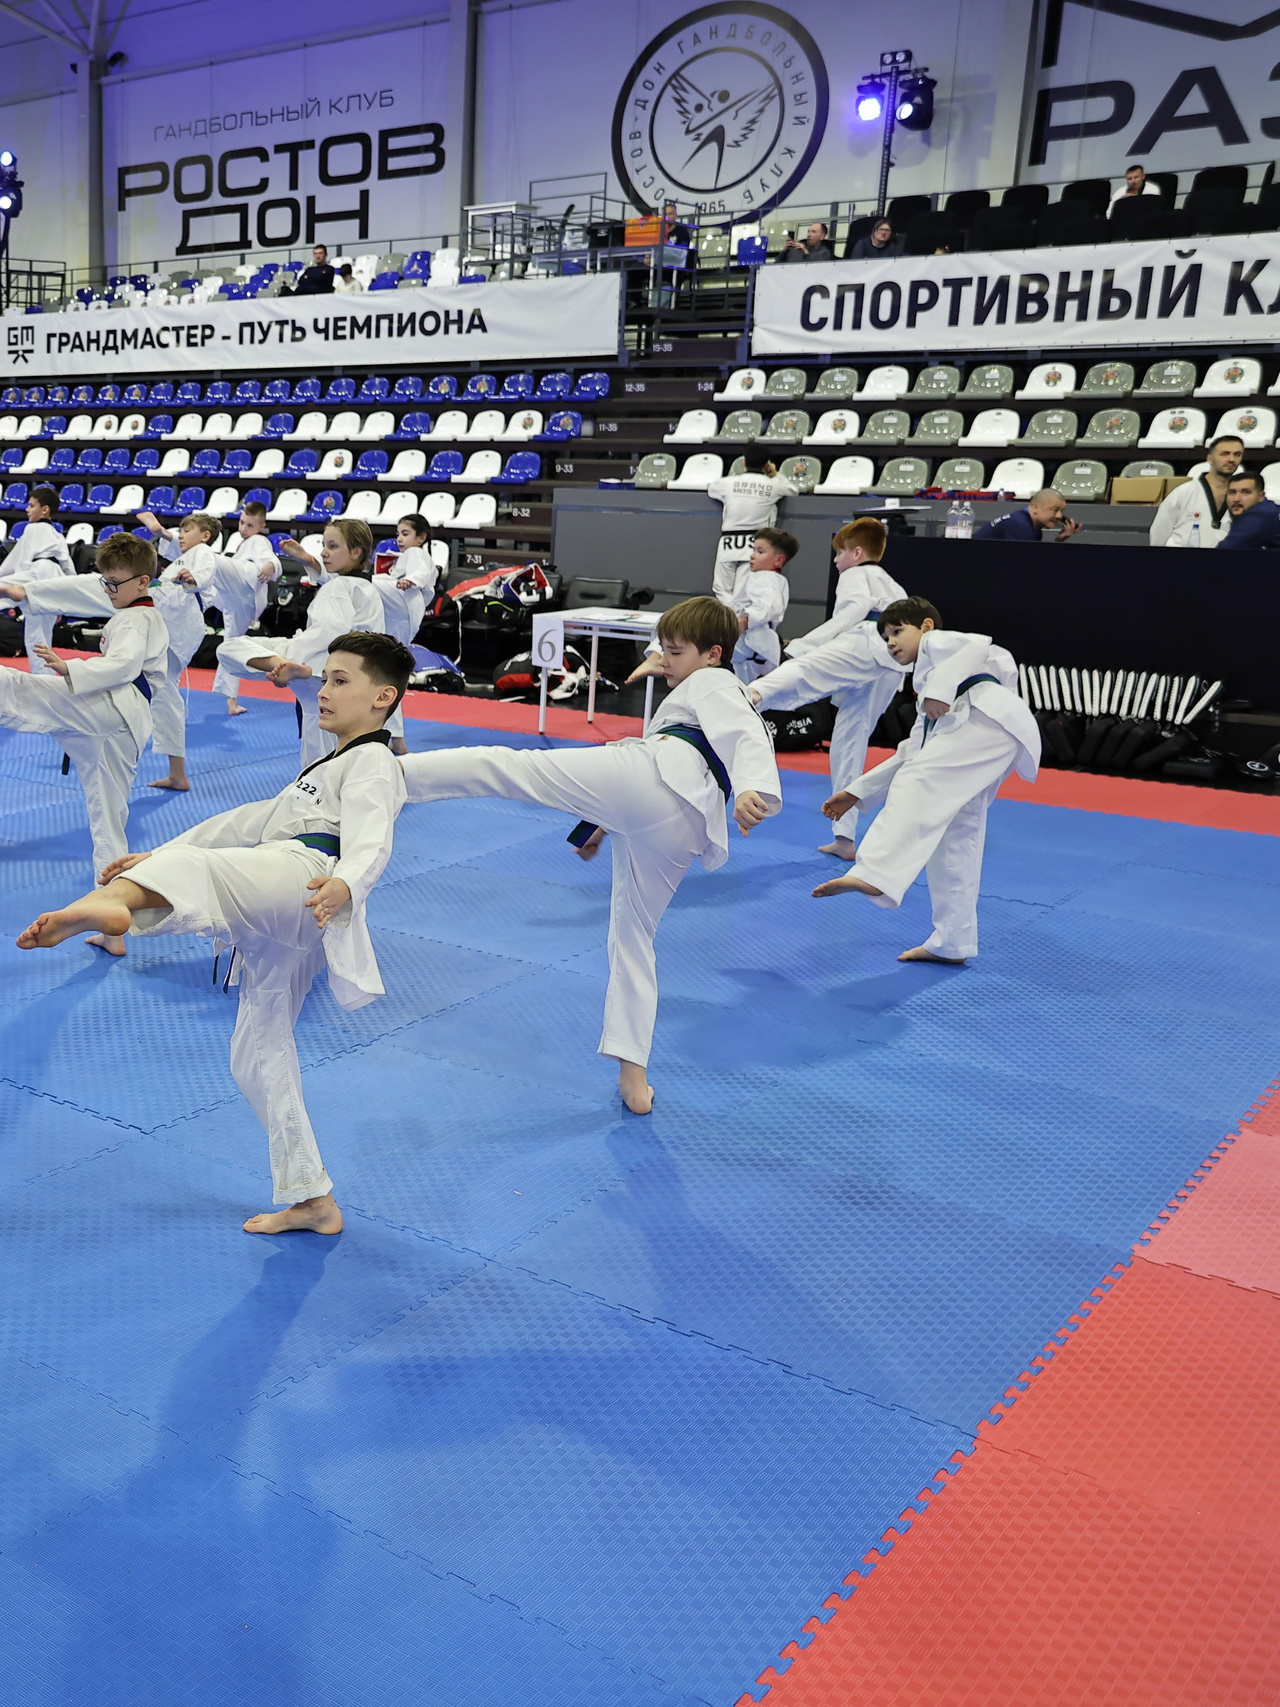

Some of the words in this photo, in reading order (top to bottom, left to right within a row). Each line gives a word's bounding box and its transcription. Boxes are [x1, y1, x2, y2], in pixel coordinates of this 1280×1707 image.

[153, 97, 321, 142] ГАНДБОЛЬНЫЙ
[328, 89, 395, 116] КЛУБ
[117, 122, 446, 212] РОСТОВ
[175, 189, 370, 256] ДОН
[800, 248, 1204, 332] СПОРТИВНЫЙ
[1223, 258, 1280, 316] К
[46, 324, 215, 355] ГРАНДМАСТЕР
[238, 319, 307, 345] ПУТЬ
[312, 308, 488, 341] ЧЕМПИОНА
[512, 508, 531, 517] 8-32
[466, 554, 482, 564] 7-31
[537, 628, 557, 662] 6
